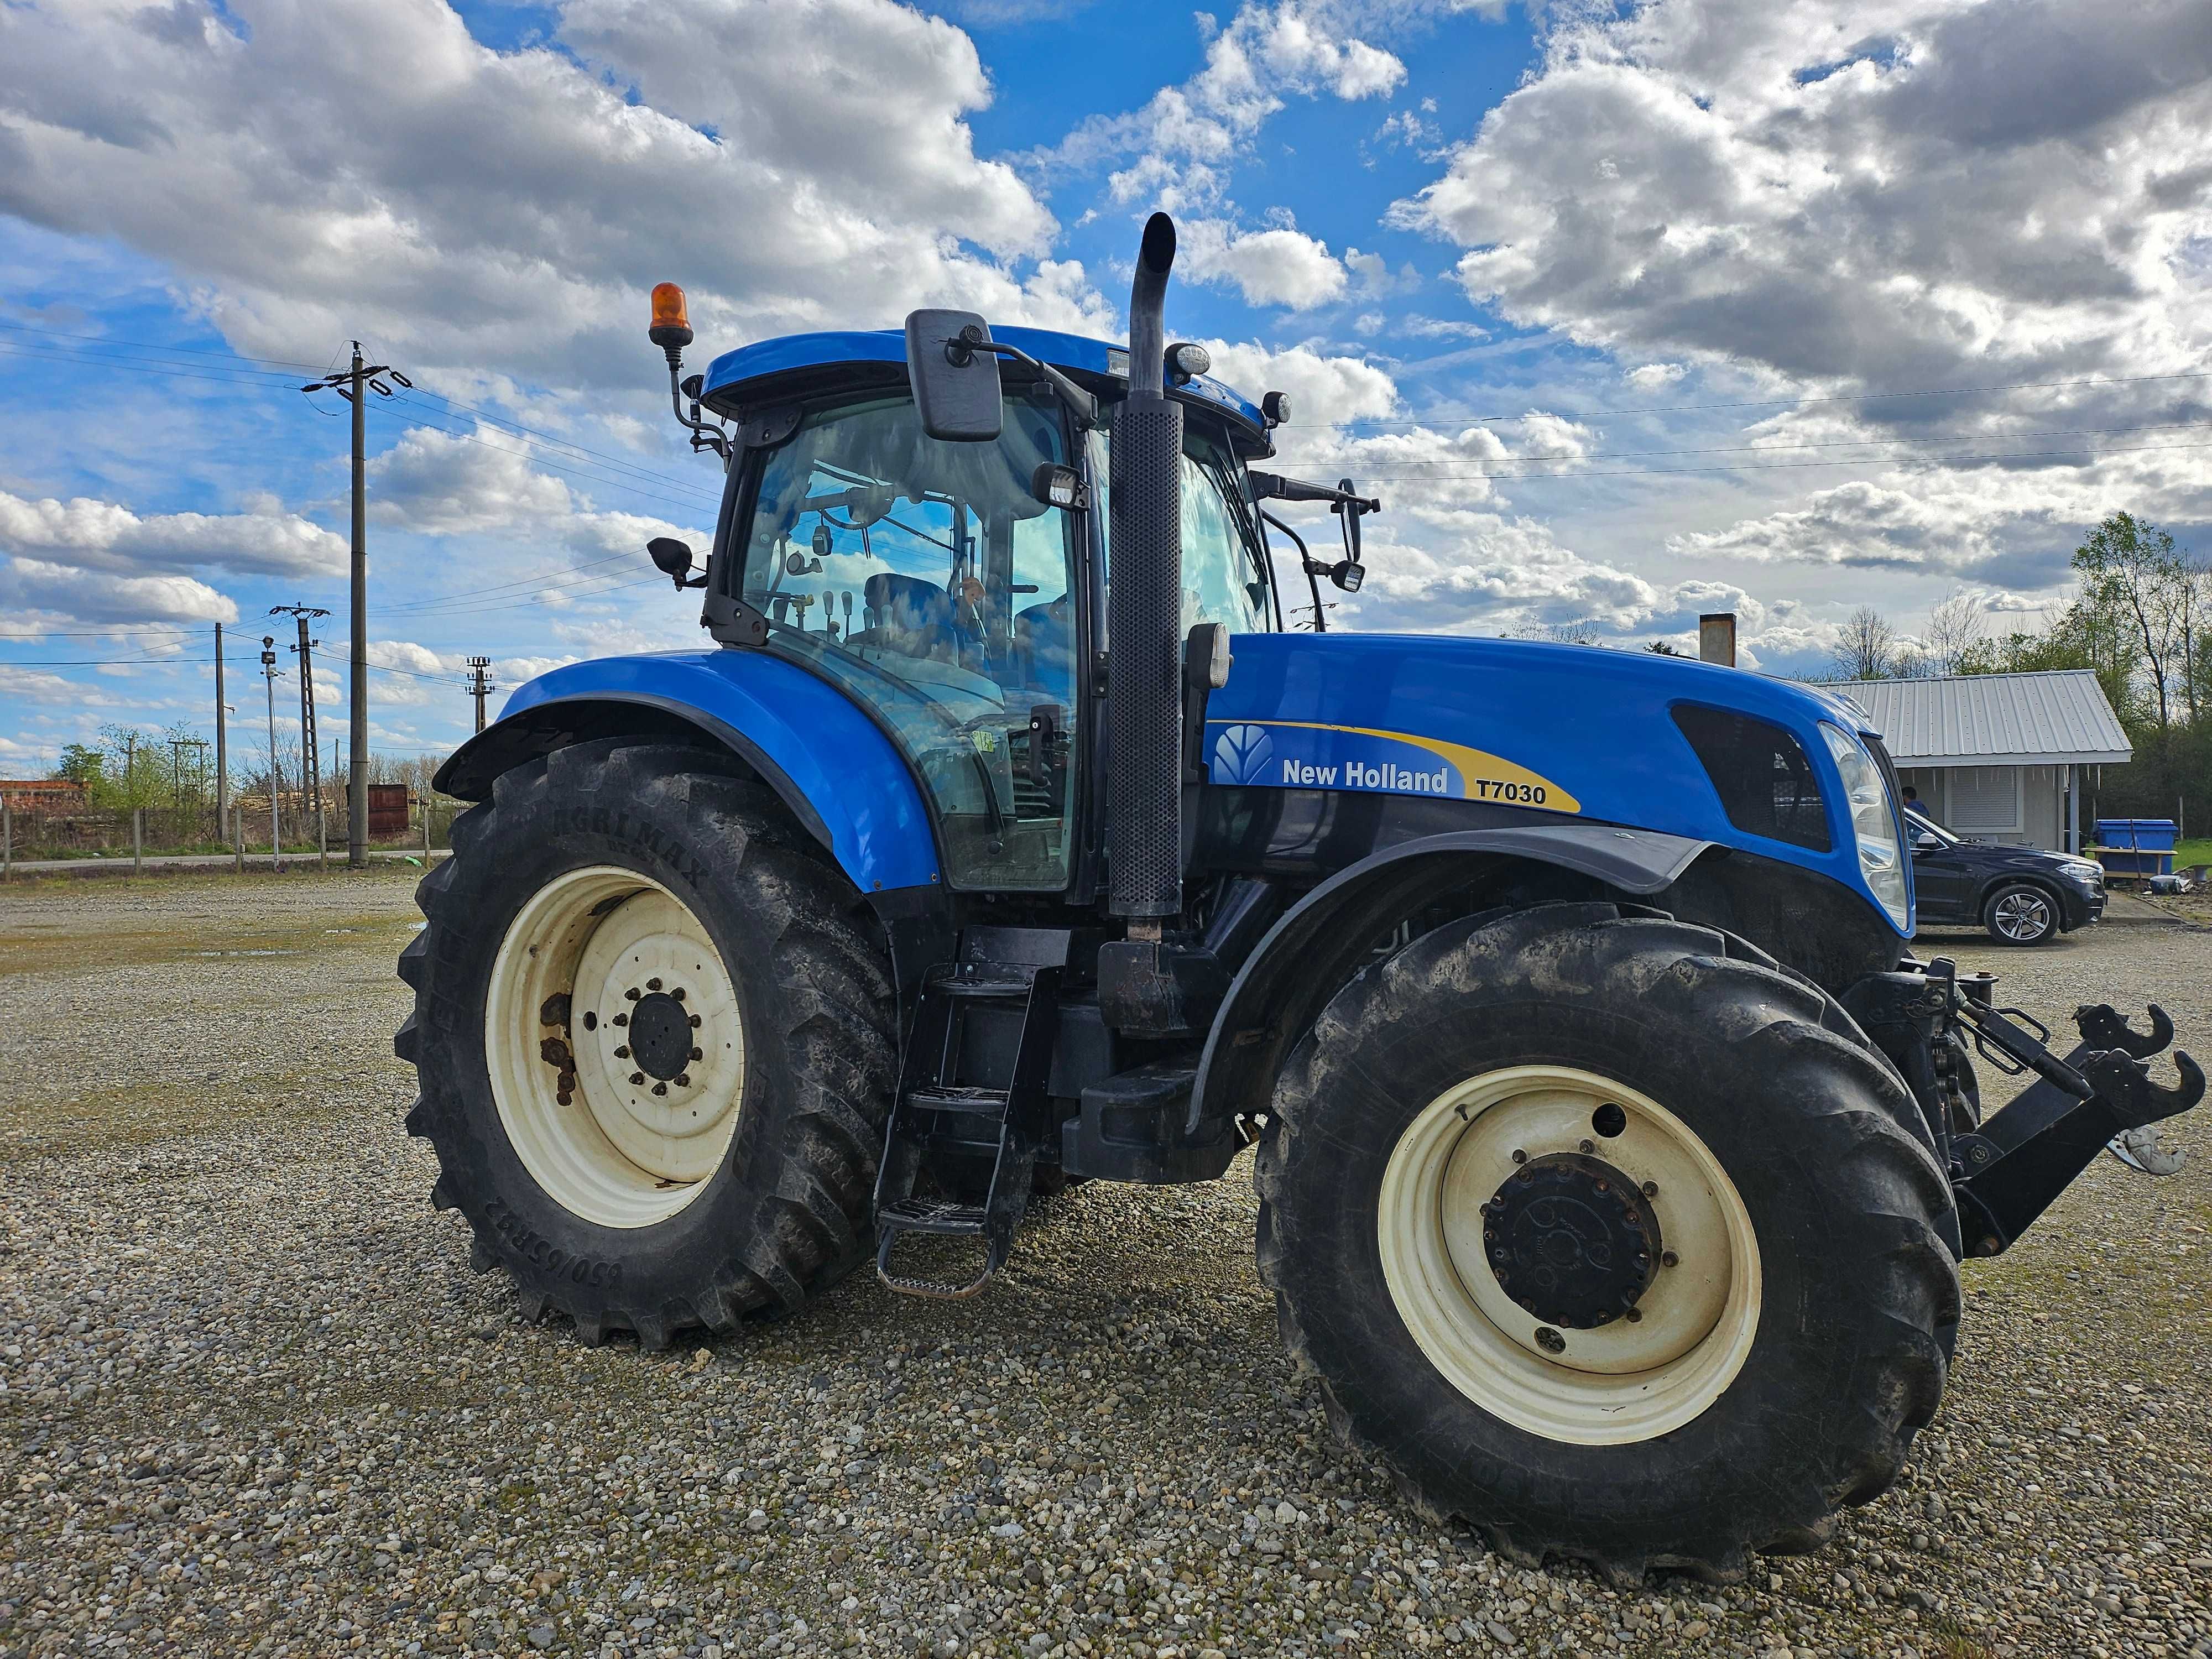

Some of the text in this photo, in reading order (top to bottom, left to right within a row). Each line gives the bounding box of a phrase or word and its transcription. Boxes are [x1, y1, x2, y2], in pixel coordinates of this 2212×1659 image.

[1283, 759, 1447, 793] New Holland
[1475, 779, 1546, 804] T7030
